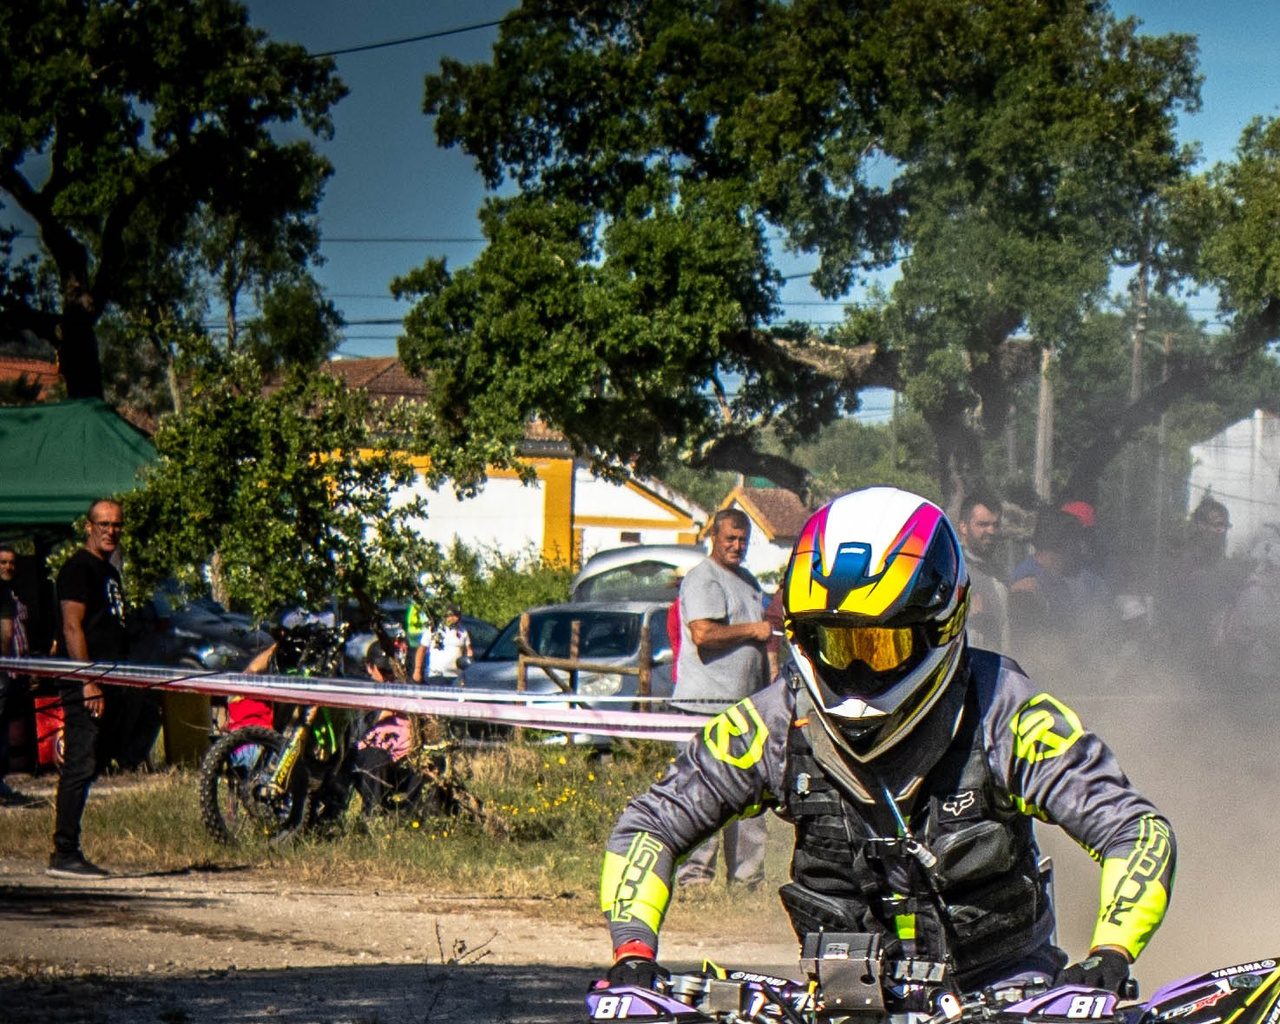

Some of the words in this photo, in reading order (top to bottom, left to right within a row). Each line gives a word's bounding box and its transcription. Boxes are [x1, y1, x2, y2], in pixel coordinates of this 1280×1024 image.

[1210, 962, 1263, 979] YAMAHA
[594, 995, 634, 1019] 81
[1066, 995, 1108, 1019] 81
